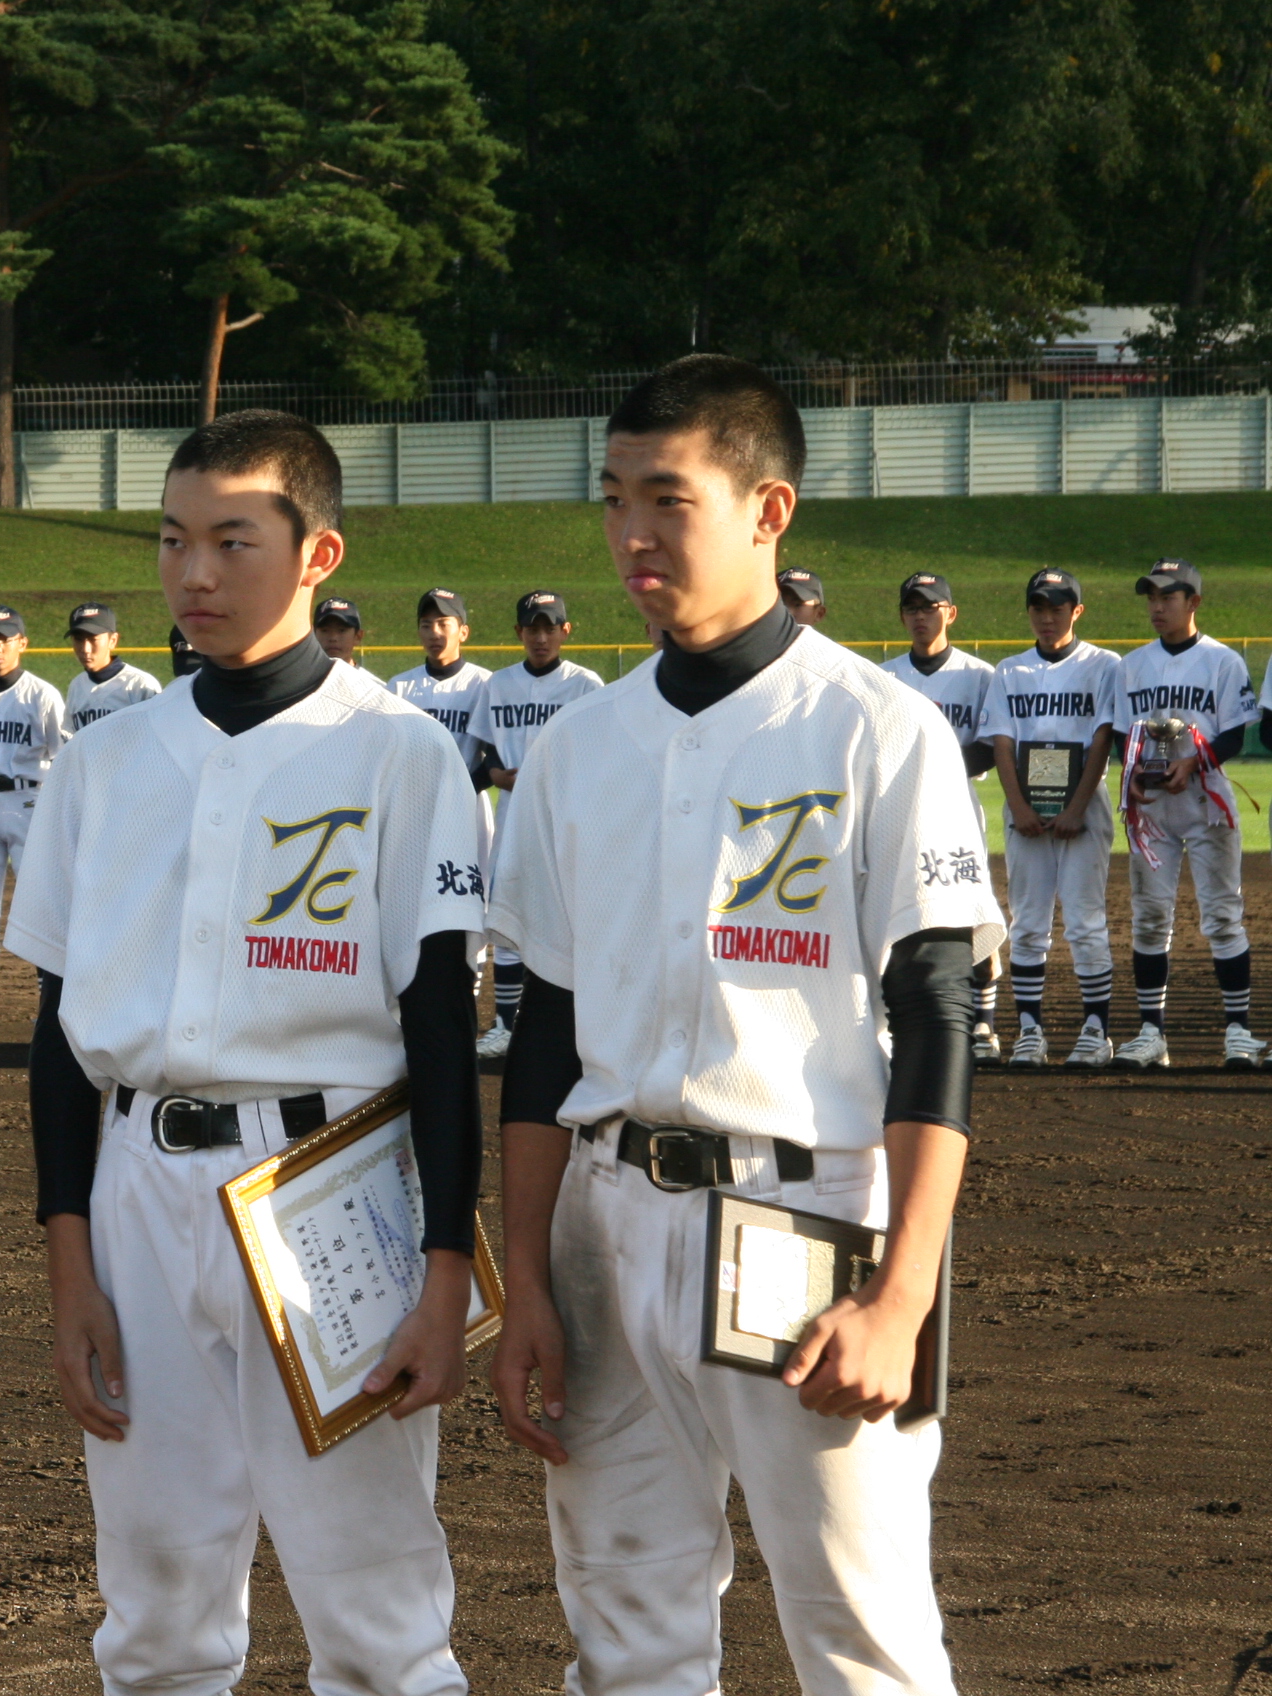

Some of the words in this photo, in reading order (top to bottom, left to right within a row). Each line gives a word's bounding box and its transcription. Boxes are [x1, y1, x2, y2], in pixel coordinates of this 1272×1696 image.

[1007, 692, 1095, 718] TOYOHIRA
[1128, 685, 1215, 715] TOYOHIRA
[245, 935, 359, 976] TOMAKOMAI
[708, 925, 831, 969] TOMAKOMAI
